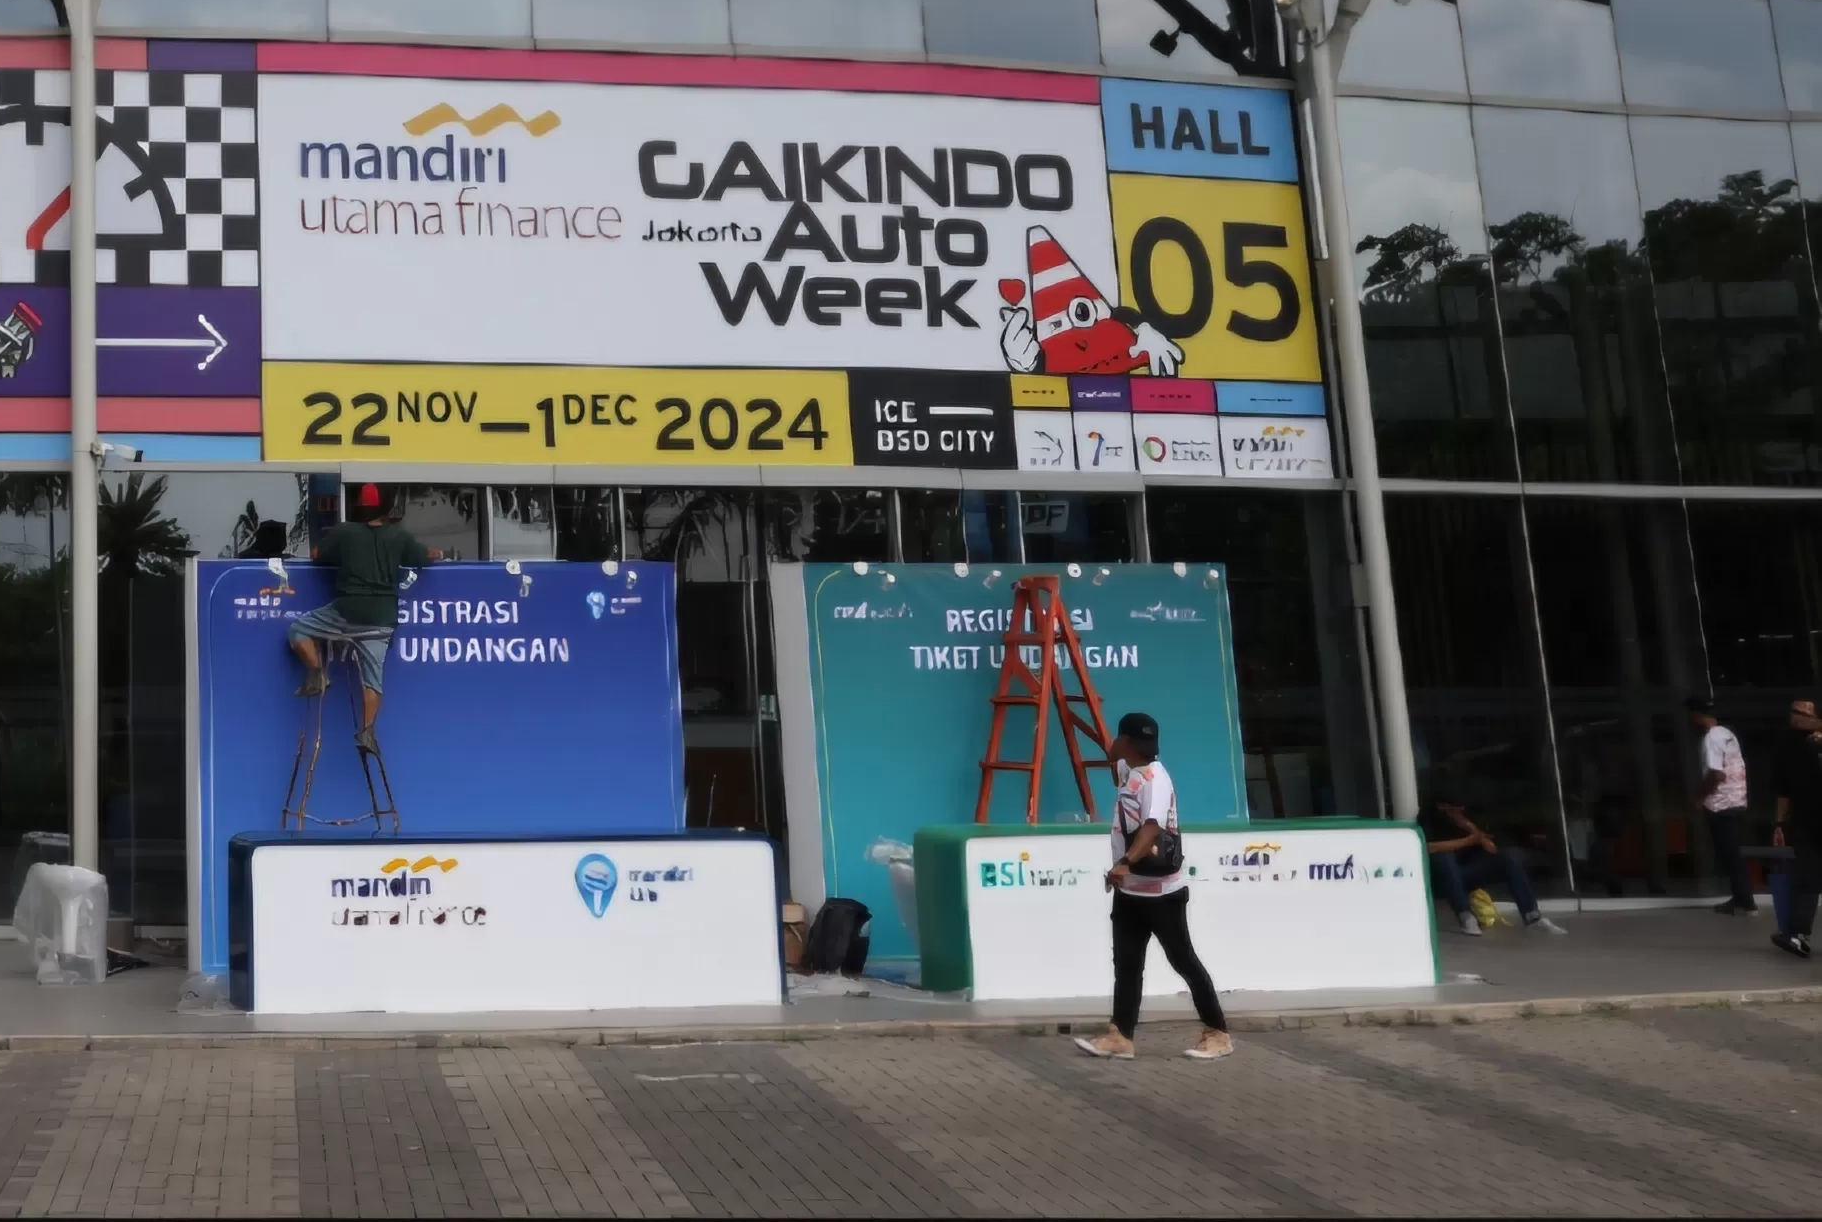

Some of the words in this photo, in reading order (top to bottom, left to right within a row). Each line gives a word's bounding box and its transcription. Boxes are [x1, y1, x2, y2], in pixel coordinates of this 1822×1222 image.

[1129, 102, 1271, 157] HALL
[299, 134, 507, 184] mandiri
[638, 140, 1074, 211] GAIKINDO
[299, 195, 446, 236] utama
[454, 186, 624, 241] finance
[763, 199, 989, 267] Auto
[699, 261, 982, 330] Week
[1129, 216, 1302, 343] 05
[397, 391, 479, 424] NOV
[562, 394, 639, 427] DEC
[655, 398, 830, 452] 2024
[875, 400, 919, 424] ICE
[877, 430, 931, 453] BSD
[940, 430, 995, 454] CITY
[397, 600, 520, 625] GISTRASI
[399, 637, 571, 664] UNDANGAN
[909, 645, 982, 671] TIKET
